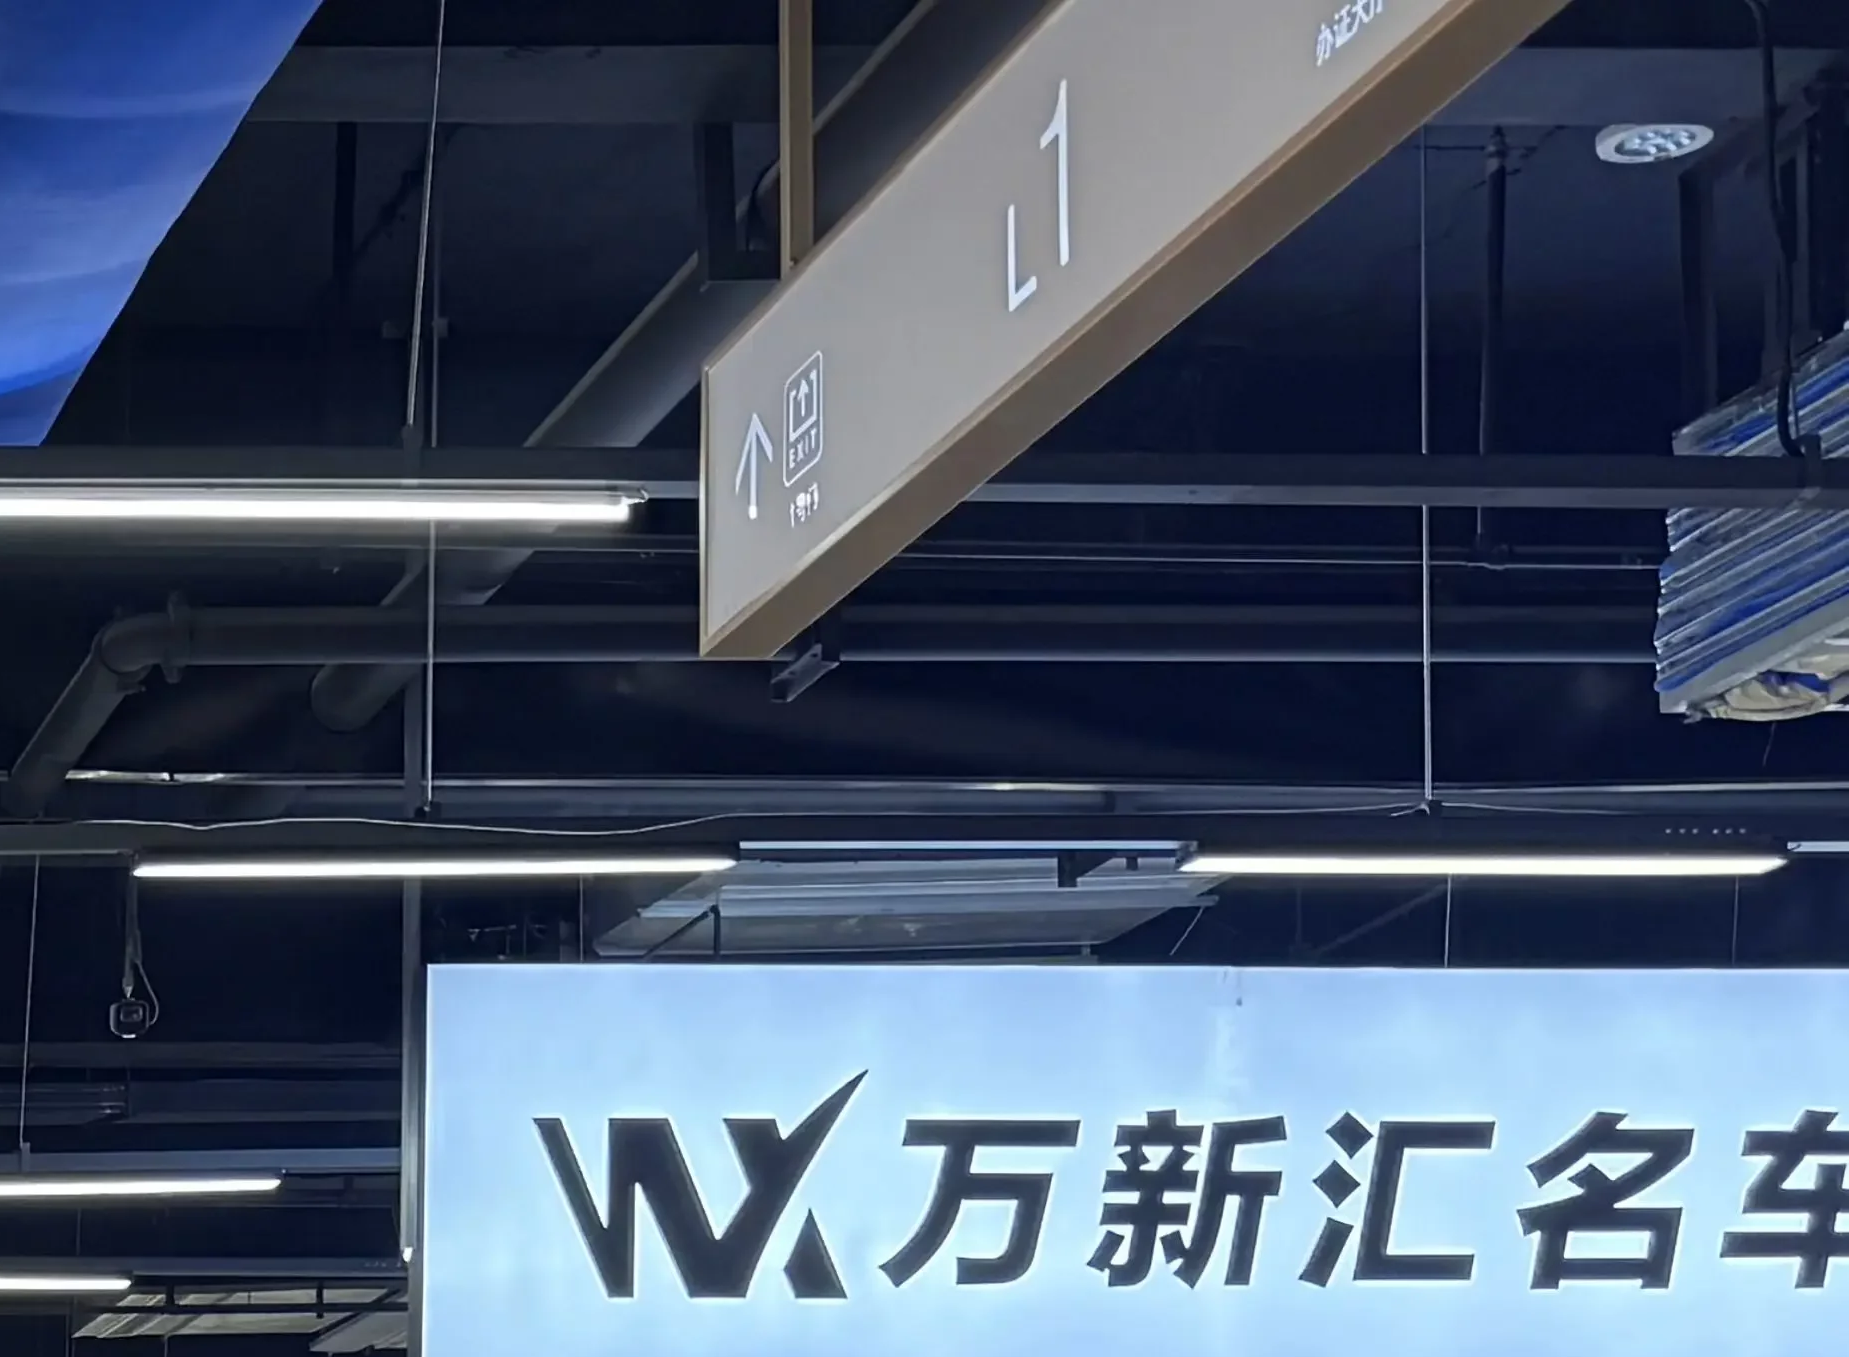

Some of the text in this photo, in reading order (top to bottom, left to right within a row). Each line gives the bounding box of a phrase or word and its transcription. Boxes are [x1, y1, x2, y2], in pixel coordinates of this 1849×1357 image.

[789, 427, 817, 470] EXIT
[878, 1107, 1849, 1290] 万新汇名车
